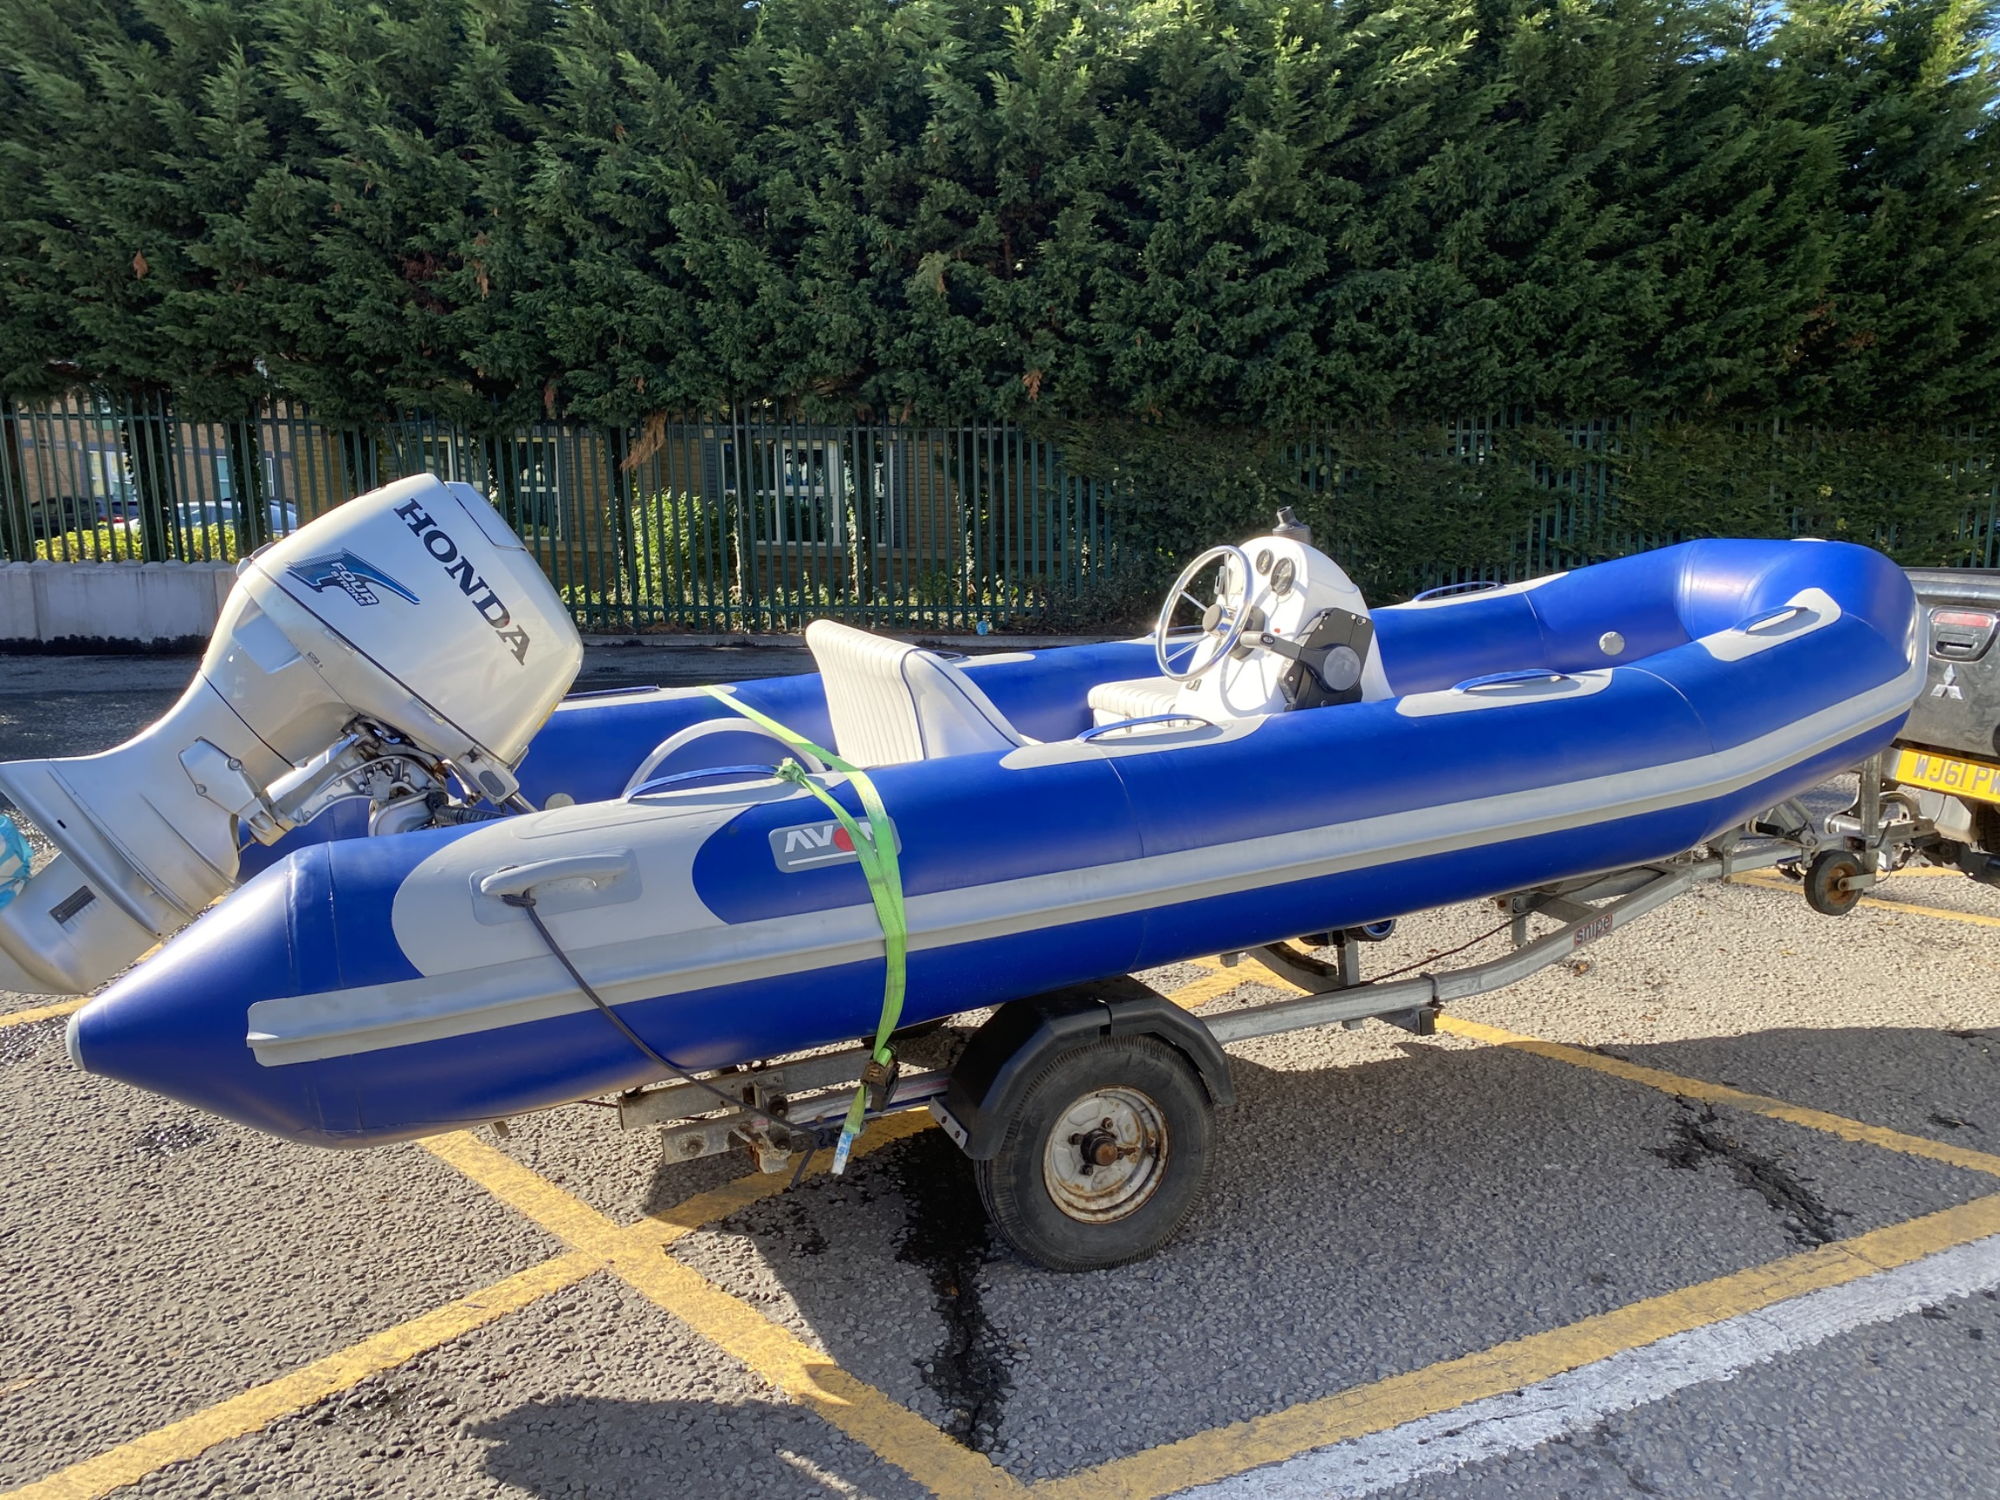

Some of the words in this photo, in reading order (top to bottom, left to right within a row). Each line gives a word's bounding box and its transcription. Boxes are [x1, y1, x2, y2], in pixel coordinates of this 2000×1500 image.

[330, 570, 368, 606] STROKE
[331, 562, 378, 604] FOUR
[393, 498, 531, 666] HONDA
[1913, 755, 1968, 788] WJ61
[1575, 915, 1611, 944] snipe
